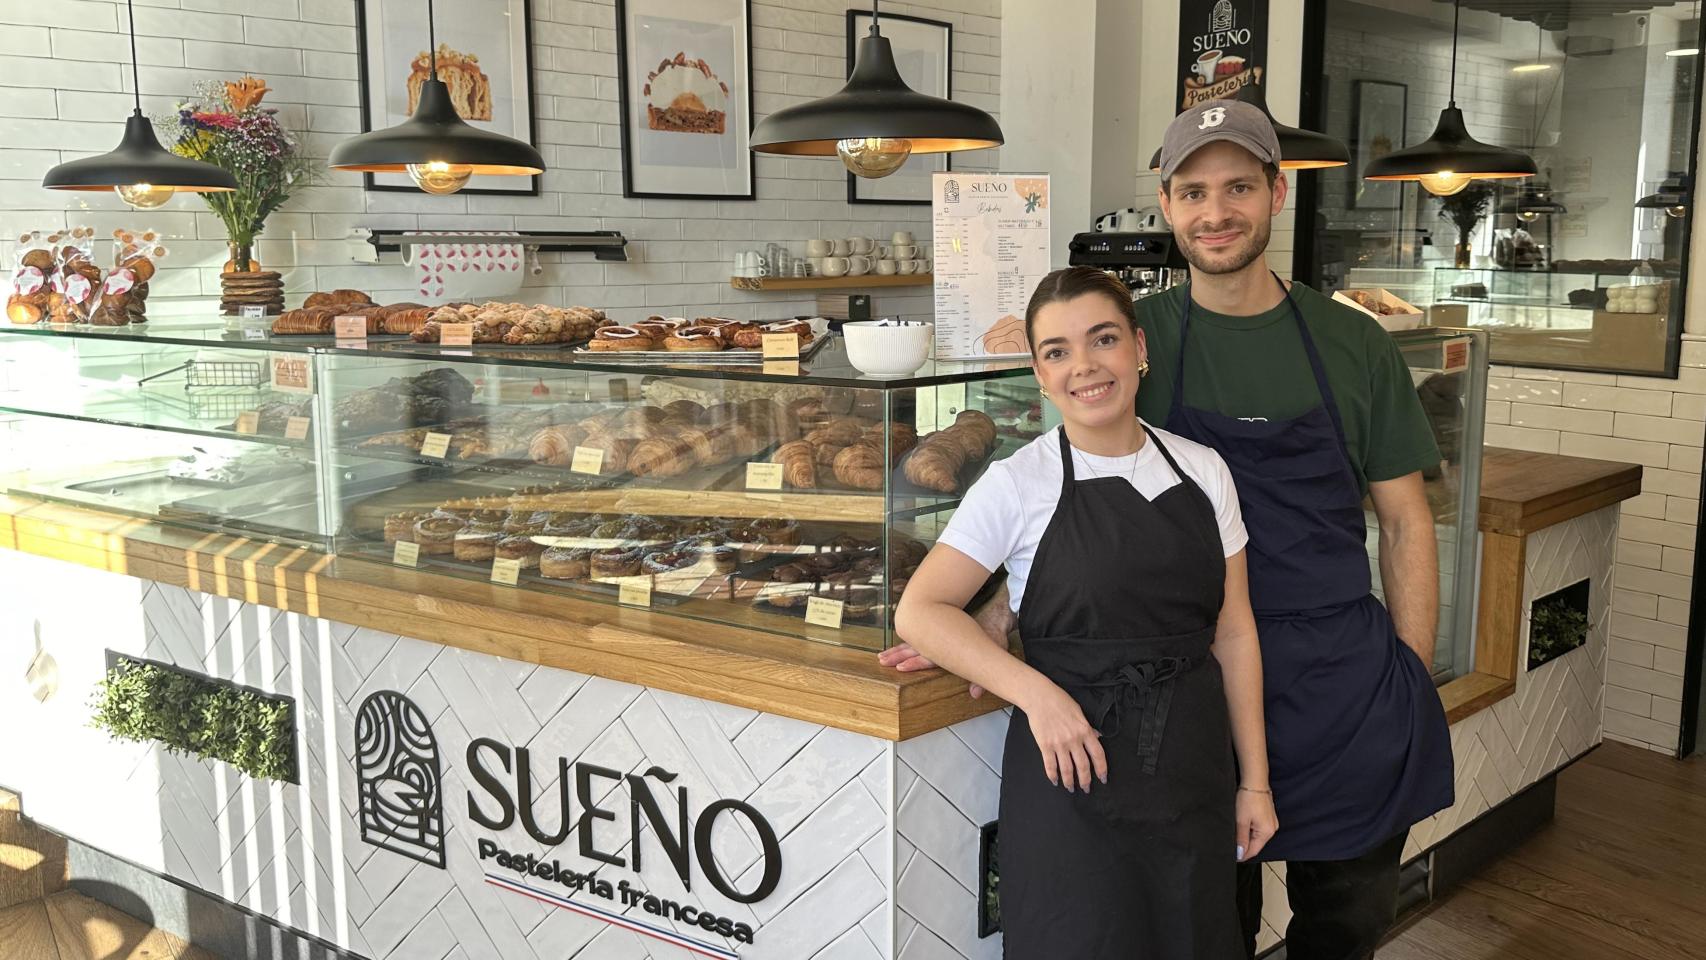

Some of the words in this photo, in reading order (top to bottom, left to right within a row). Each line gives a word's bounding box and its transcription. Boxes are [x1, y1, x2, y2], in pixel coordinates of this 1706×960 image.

[466, 737, 782, 904] SUEÑO
[478, 837, 613, 900] Pastelería
[617, 880, 754, 944] francesa
